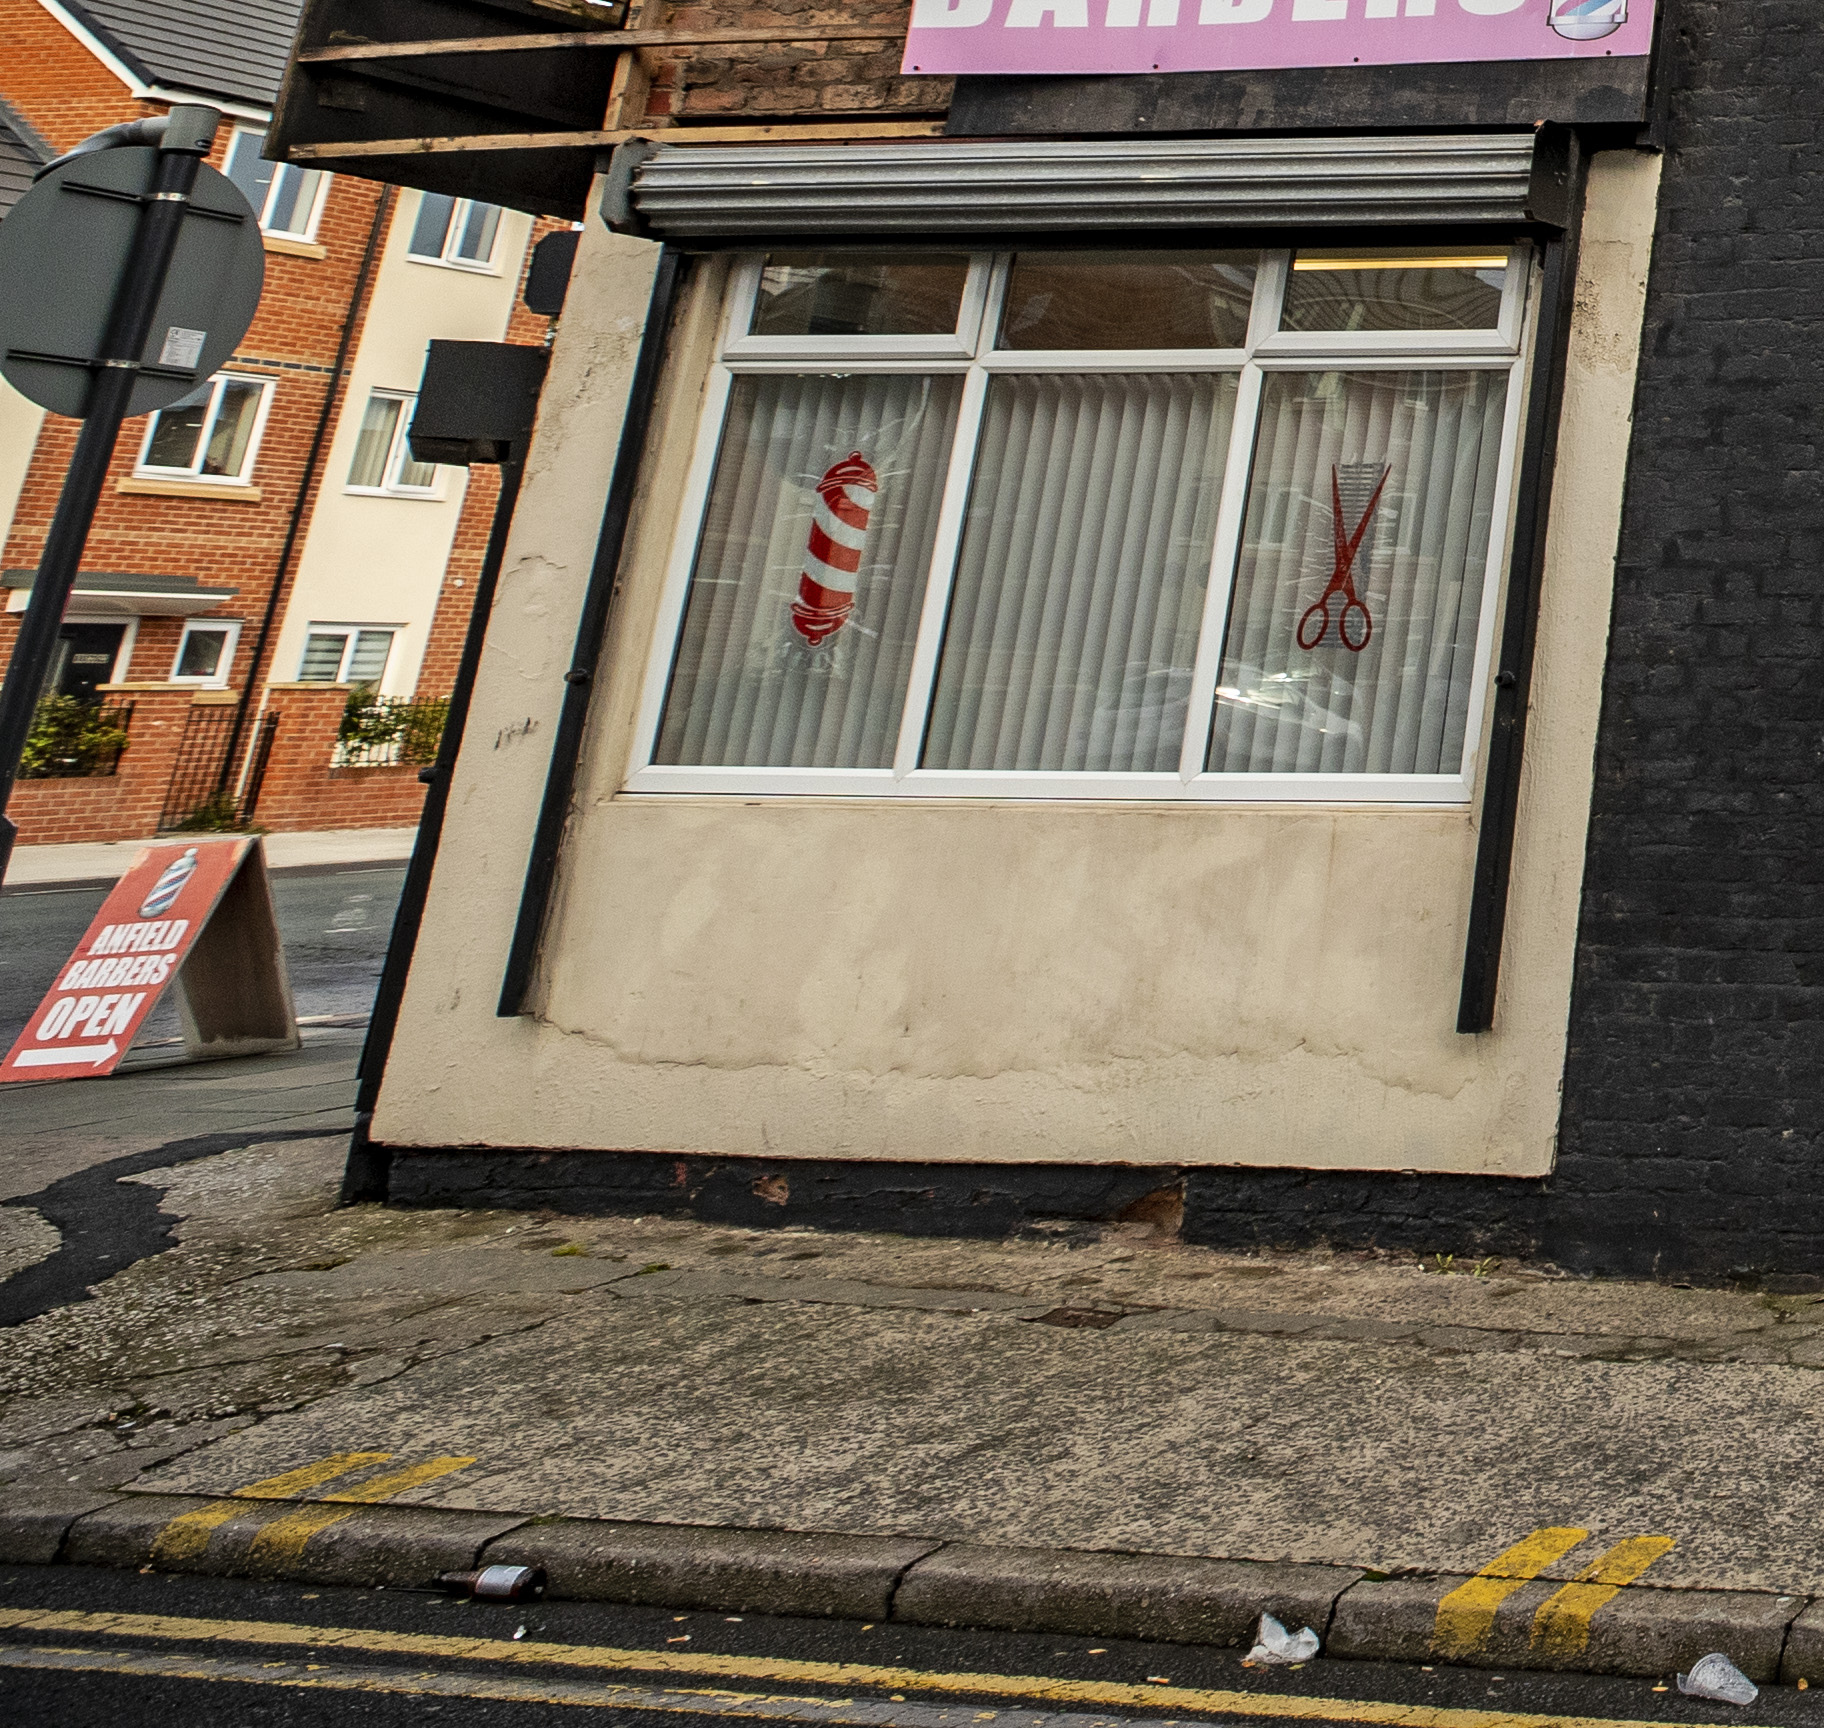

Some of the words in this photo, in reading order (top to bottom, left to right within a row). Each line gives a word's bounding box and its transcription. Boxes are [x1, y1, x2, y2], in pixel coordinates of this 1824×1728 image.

[87, 919, 190, 956] ANFIELD
[57, 952, 178, 992] BARBERS
[35, 991, 148, 1041] OPEN
